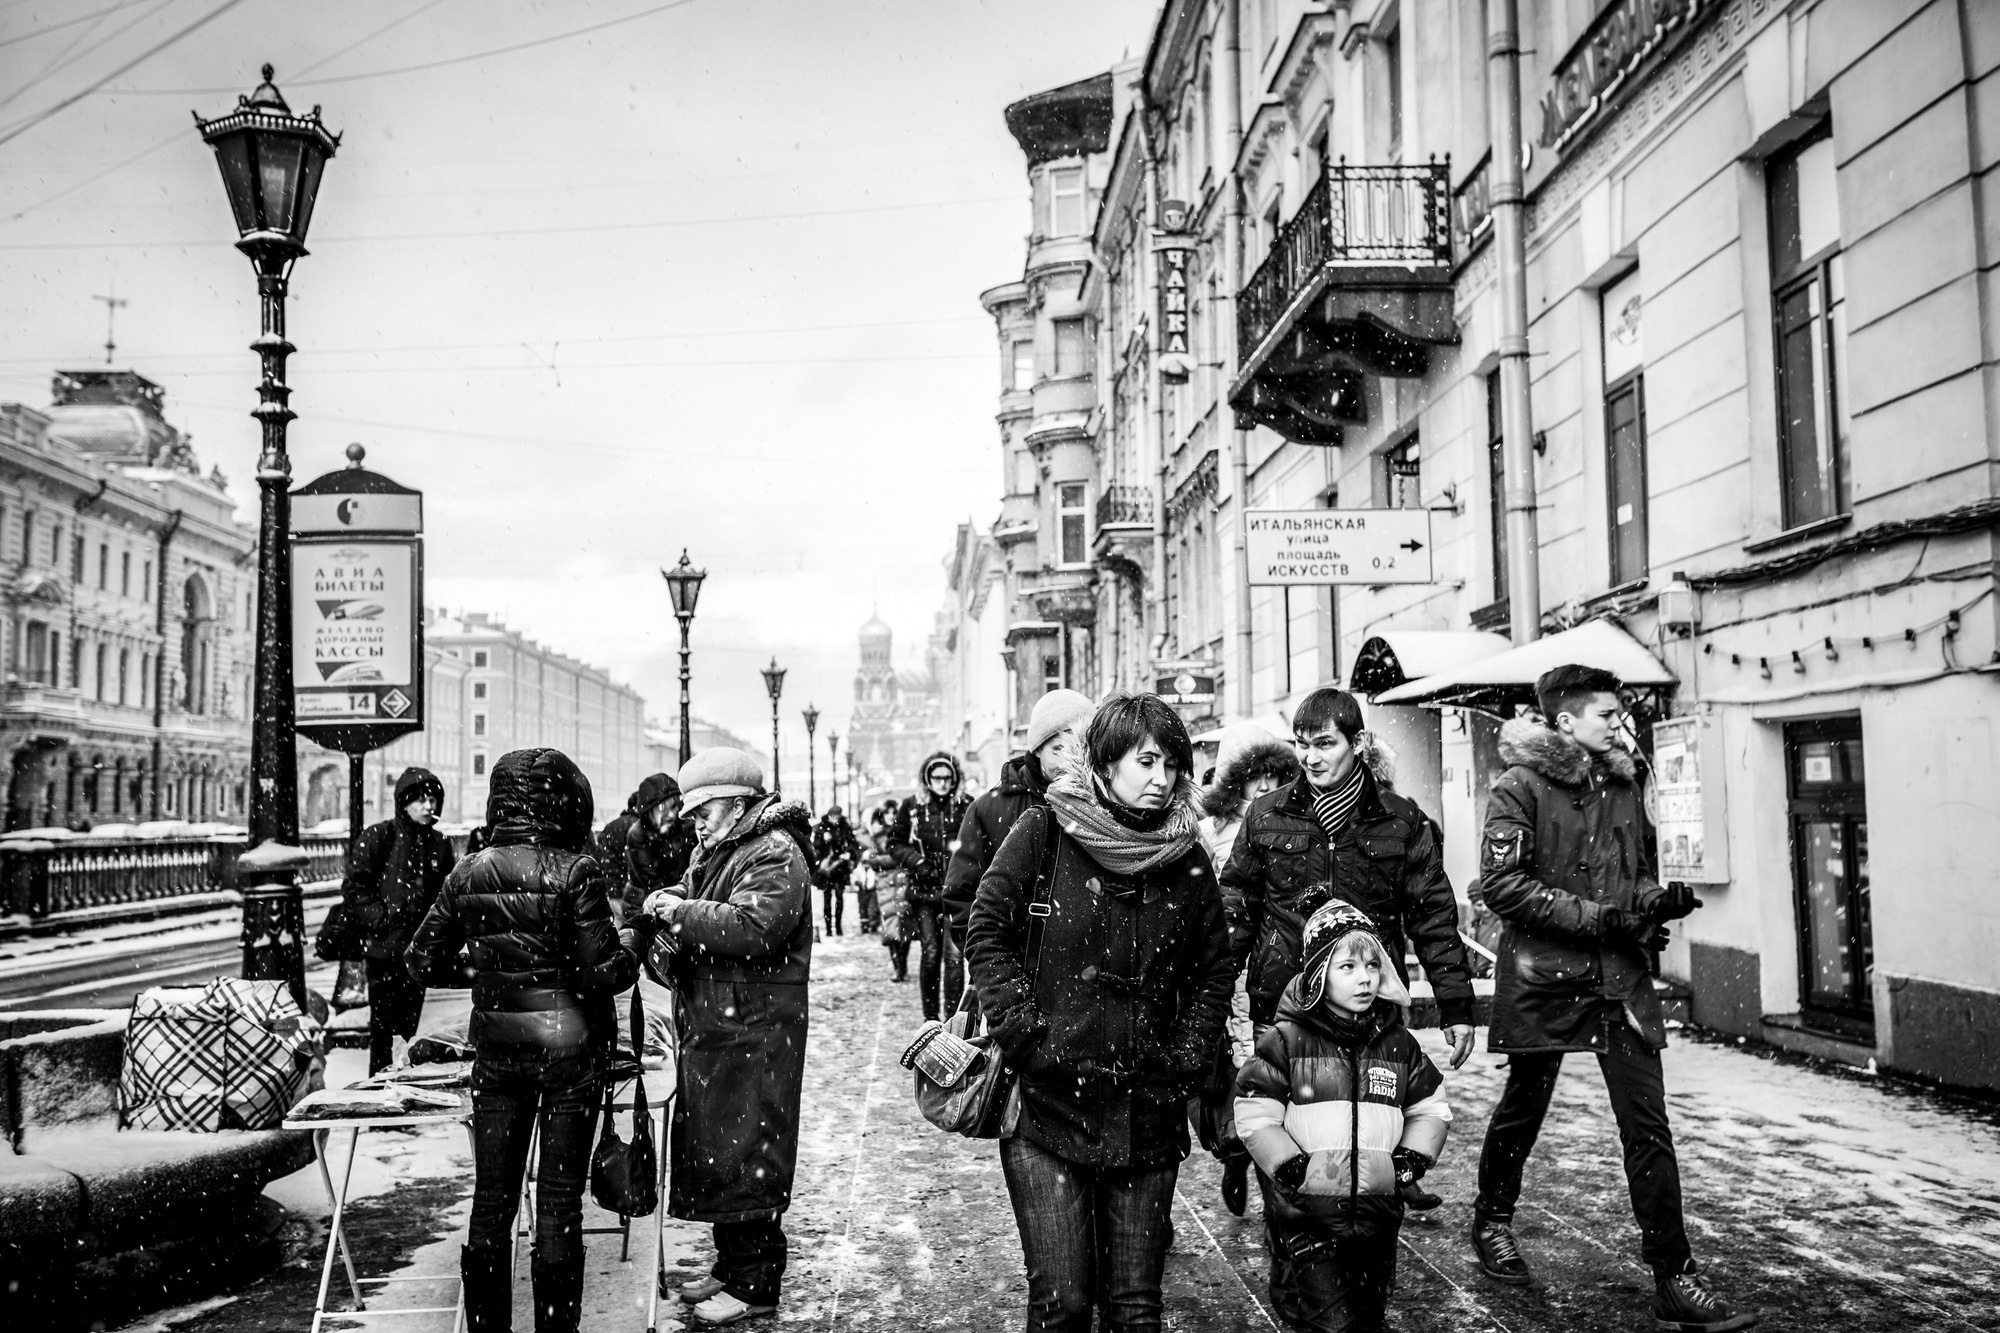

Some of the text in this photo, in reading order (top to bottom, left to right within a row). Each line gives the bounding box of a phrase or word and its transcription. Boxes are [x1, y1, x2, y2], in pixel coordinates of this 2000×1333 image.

[1250, 517, 1366, 531] ИТАЛЬЯНСКАЯ
[1277, 549, 1341, 561] площадь
[315, 567, 385, 579] АВИА
[1267, 564, 1350, 577] ИСКУССТВ
[315, 580, 384, 592] БИЛЕТЫ
[315, 626, 384, 635] ЖЕЛЕЗНО
[315, 636, 383, 645] ДОРОЖНЫЕ
[315, 646, 384, 658] КАССЫ
[348, 694, 370, 711] 14
